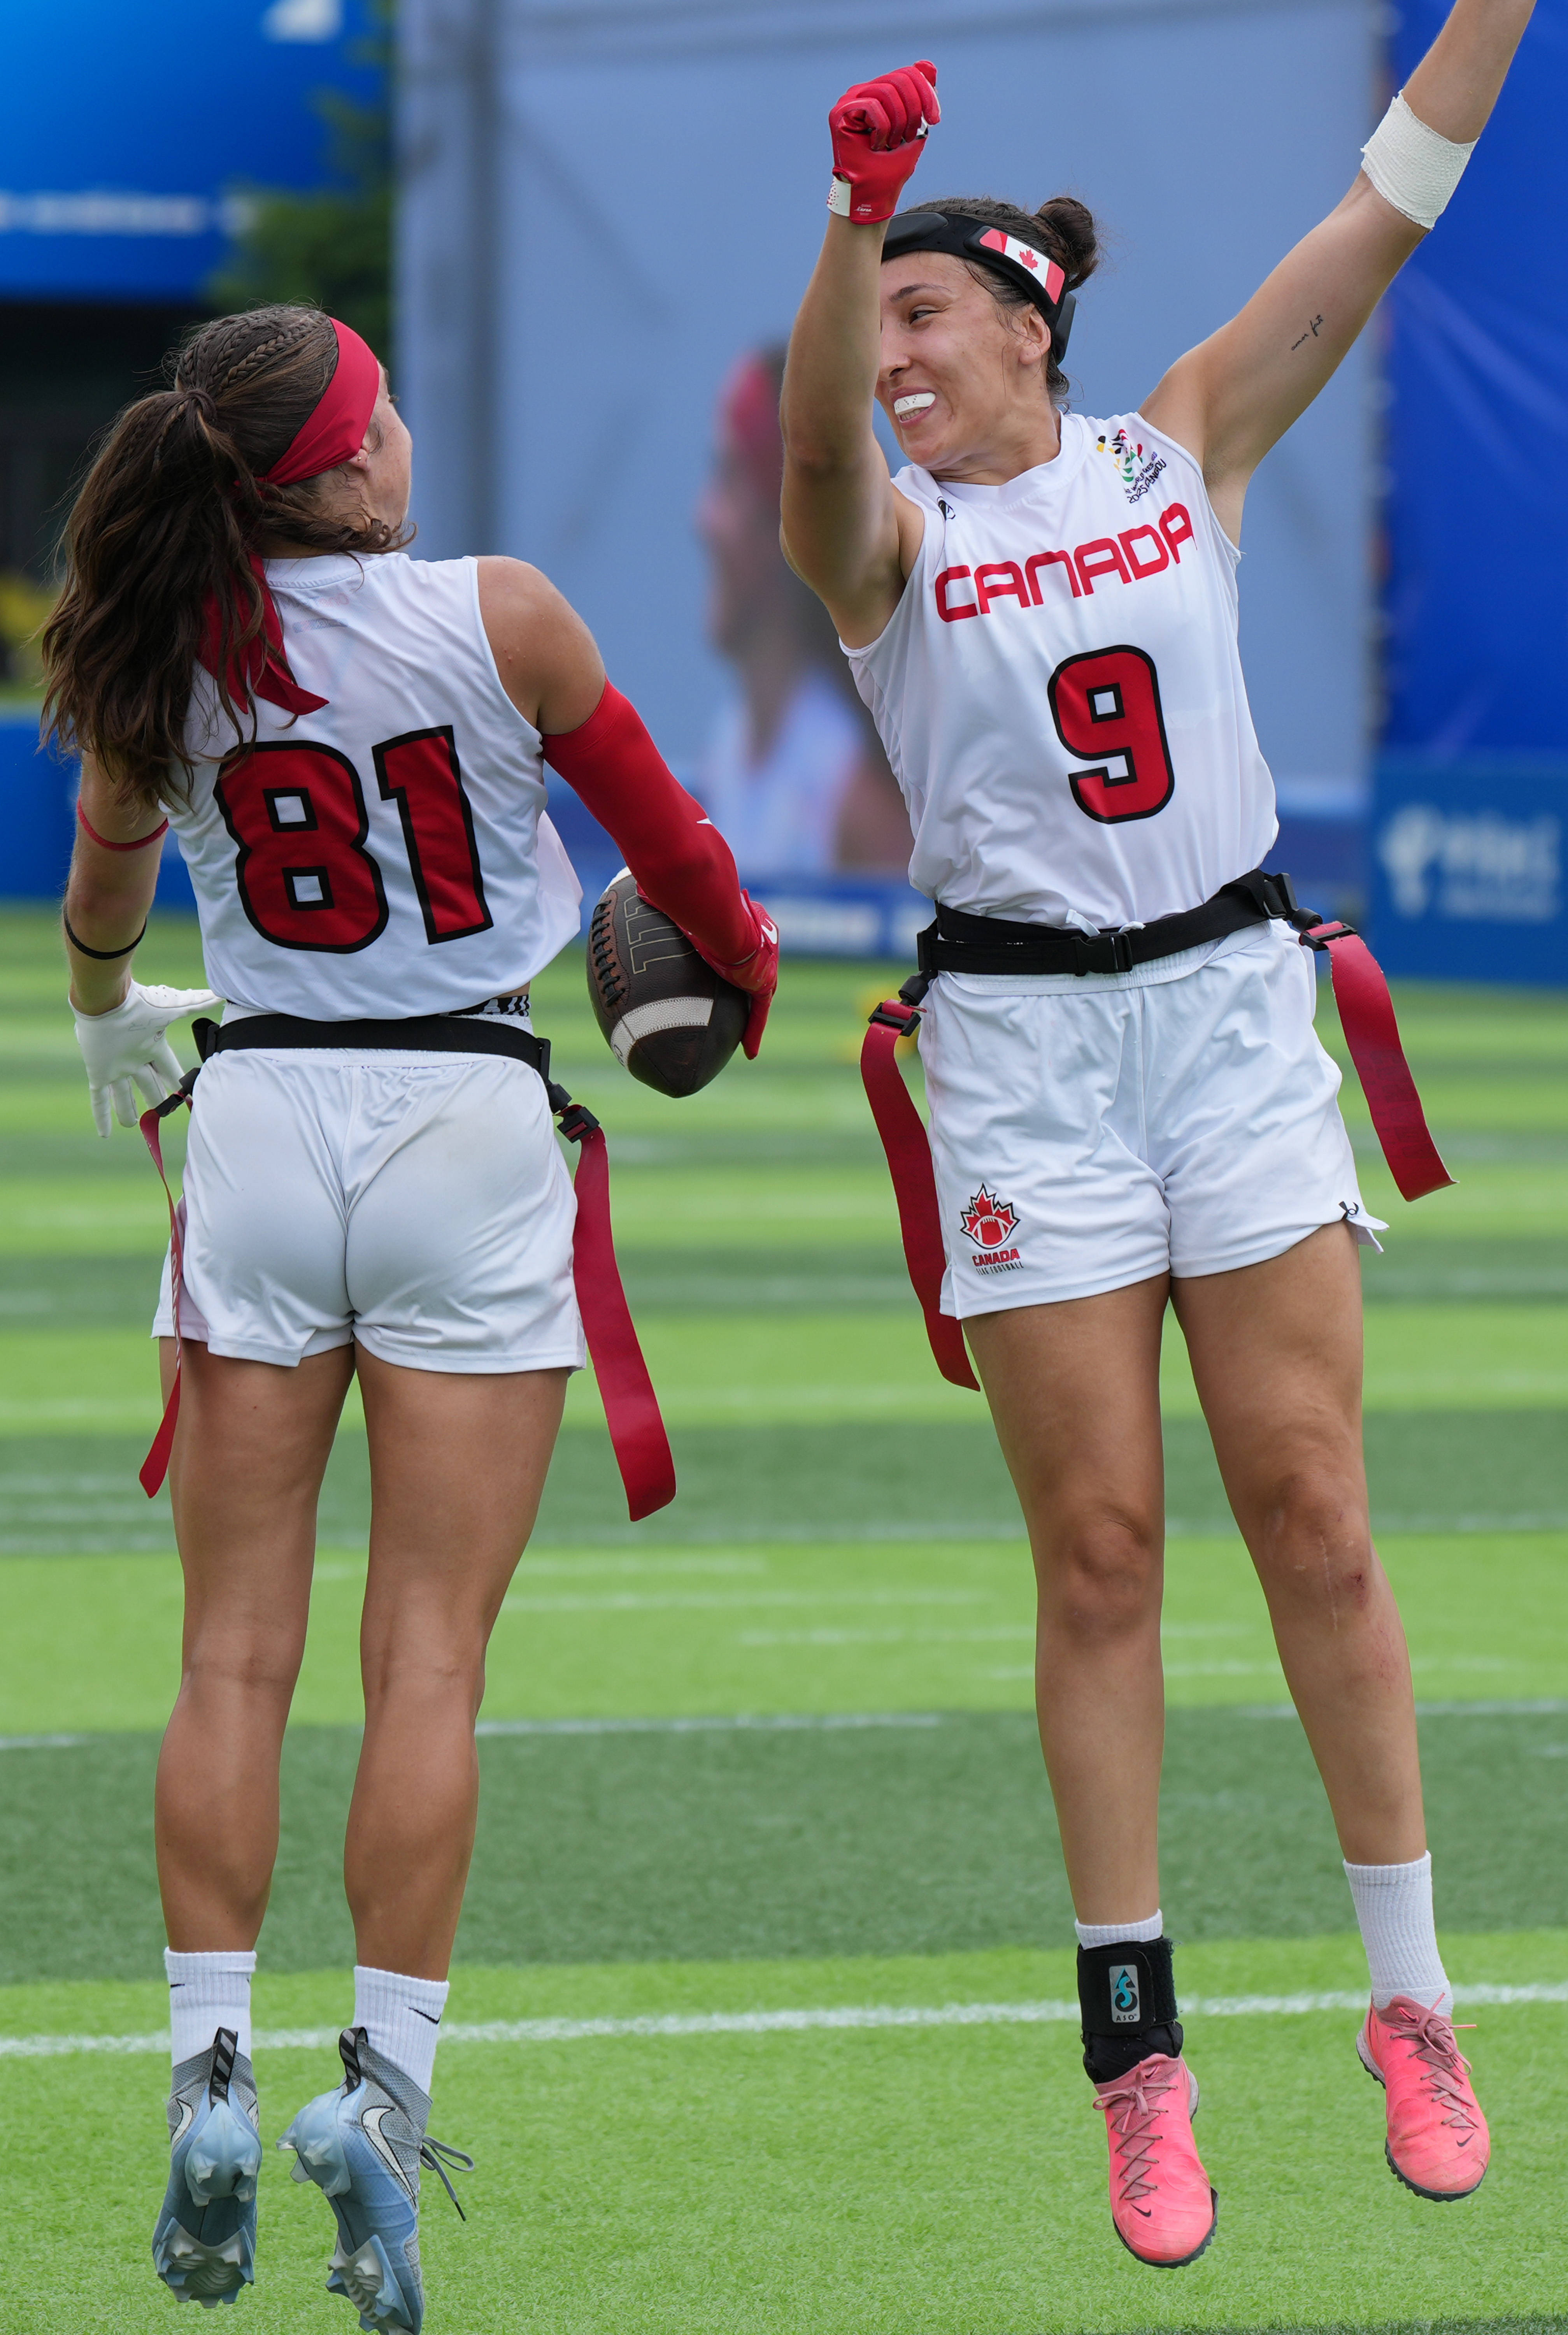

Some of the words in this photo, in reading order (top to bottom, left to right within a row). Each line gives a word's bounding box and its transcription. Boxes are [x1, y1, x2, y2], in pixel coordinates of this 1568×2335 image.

[1127, 485, 1148, 504] 2025
[935, 502, 1198, 623] CANADA
[1047, 644, 1175, 825] 9
[213, 725, 494, 954] 81
[972, 1248, 1020, 1266] CANADA
[990, 1261, 1024, 1274] FOOTBALL
